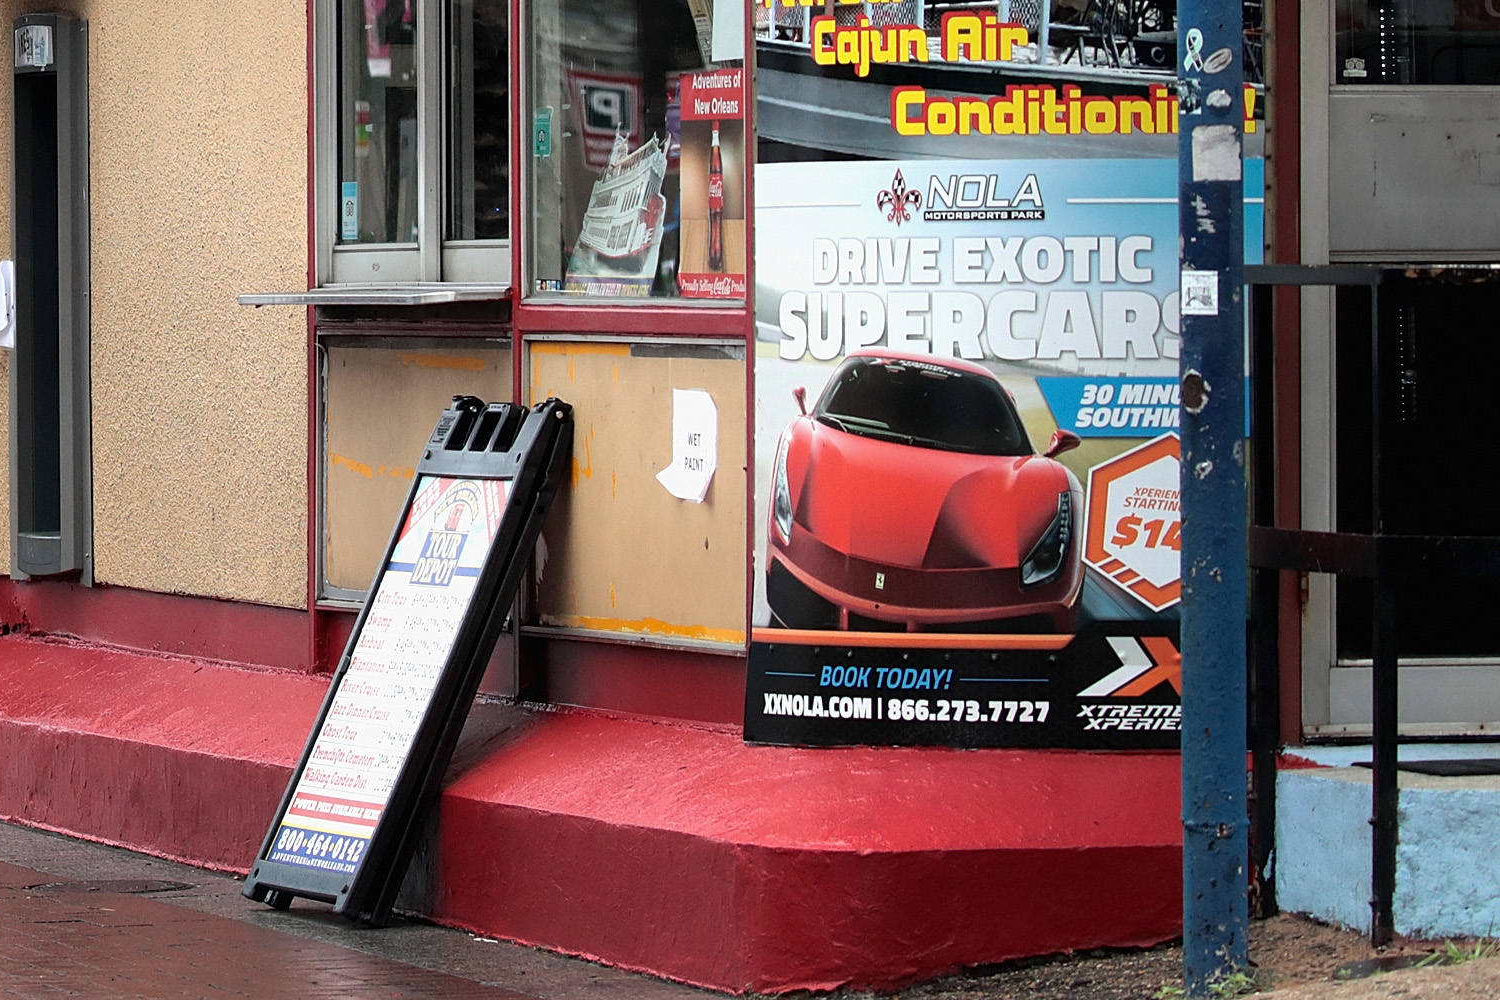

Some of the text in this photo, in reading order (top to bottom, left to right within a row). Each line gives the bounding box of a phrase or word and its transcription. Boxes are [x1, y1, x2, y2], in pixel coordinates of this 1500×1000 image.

[811, 10, 1030, 77] Cajun Air
[692, 71, 742, 90] Adventures of
[694, 97, 739, 116] New Orleans
[926, 174, 1044, 209] NOLA
[924, 211, 1043, 220] MOTORSPORTS PARK
[812, 235, 1153, 286] DRIVE EXOTIC
[681, 279, 699, 293] Proudly
[699, 279, 713, 293] Selling
[1080, 383, 1114, 406] 30
[687, 433, 701, 447] WET
[684, 457, 704, 472] PAINT
[426, 532, 462, 560] TOUR
[411, 558, 458, 585] DEPOT
[368, 612, 393, 632] Swamp
[349, 656, 385, 674] Plantation
[340, 678, 360, 693] River
[819, 665, 954, 690] BOOK TODAY!
[763, 692, 1050, 723] XXNOLA.COM 866.273.7727
[322, 722, 343, 739] Ghost
[303, 767, 331, 789] Walking
[330, 771, 354, 787] Garden
